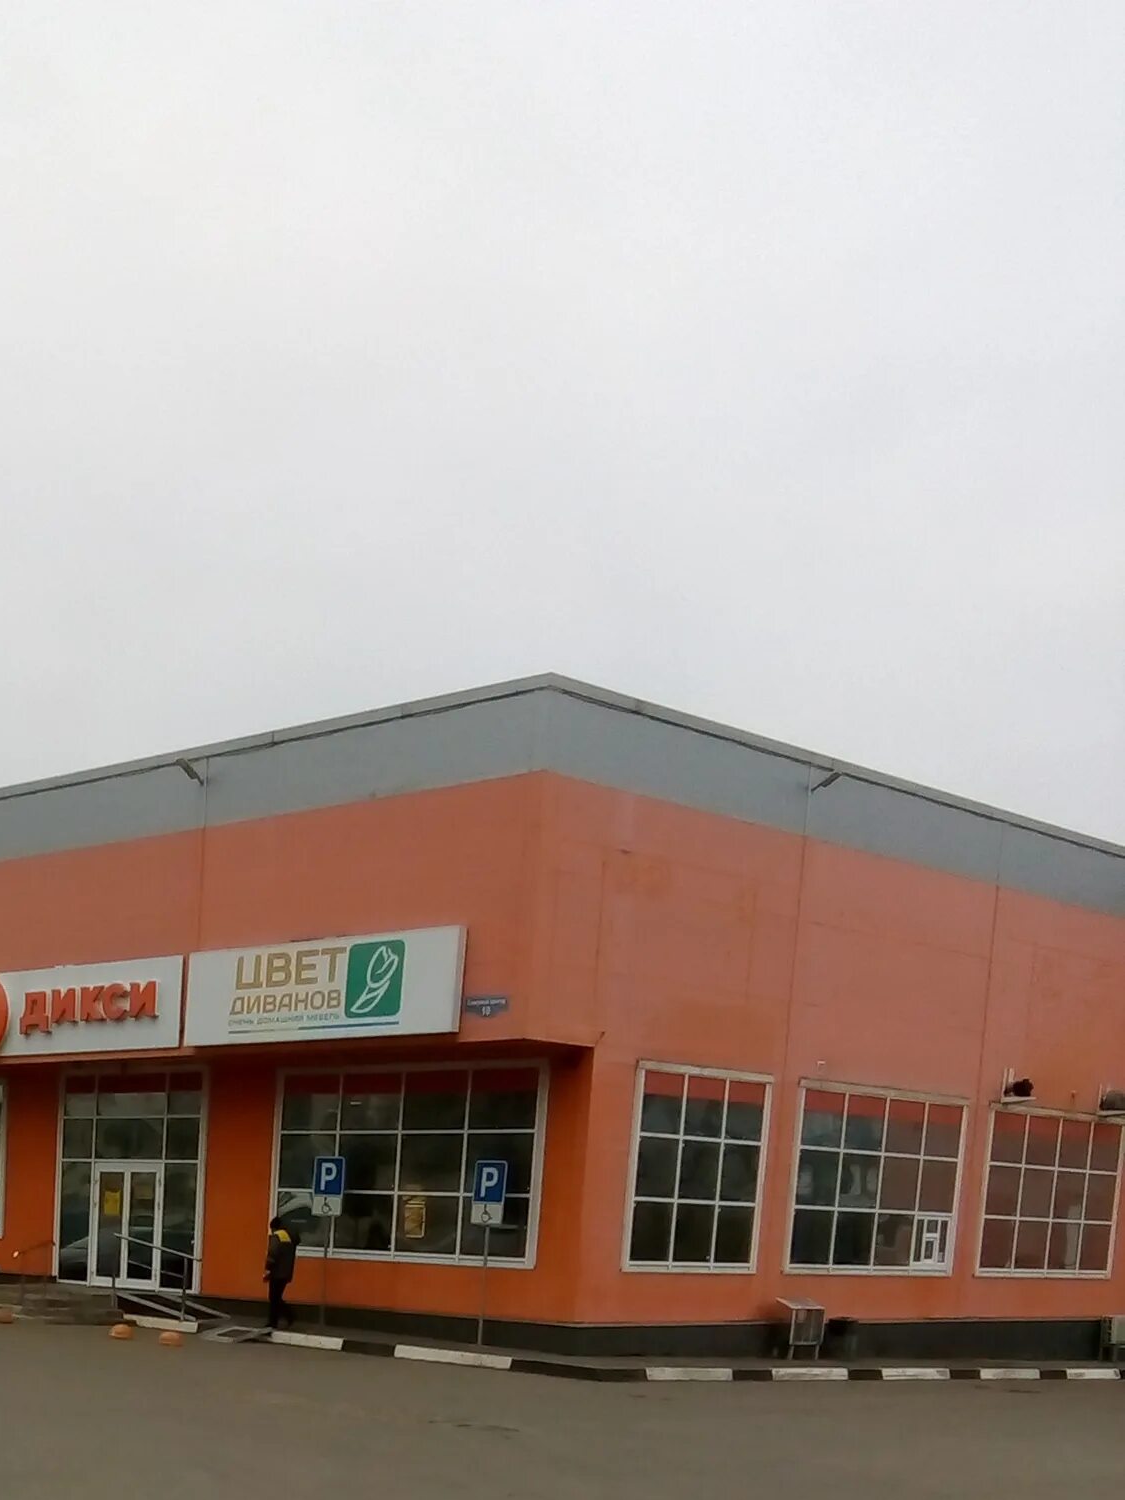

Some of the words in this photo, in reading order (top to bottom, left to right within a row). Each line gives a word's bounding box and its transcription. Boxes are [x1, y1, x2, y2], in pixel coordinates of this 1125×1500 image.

[235, 946, 348, 990] ЦВЕТ
[19, 980, 160, 1036] ДИКСИ
[228, 988, 342, 1017] ДИВАНОВ
[319, 1161, 338, 1191] P
[479, 1166, 500, 1198] P
